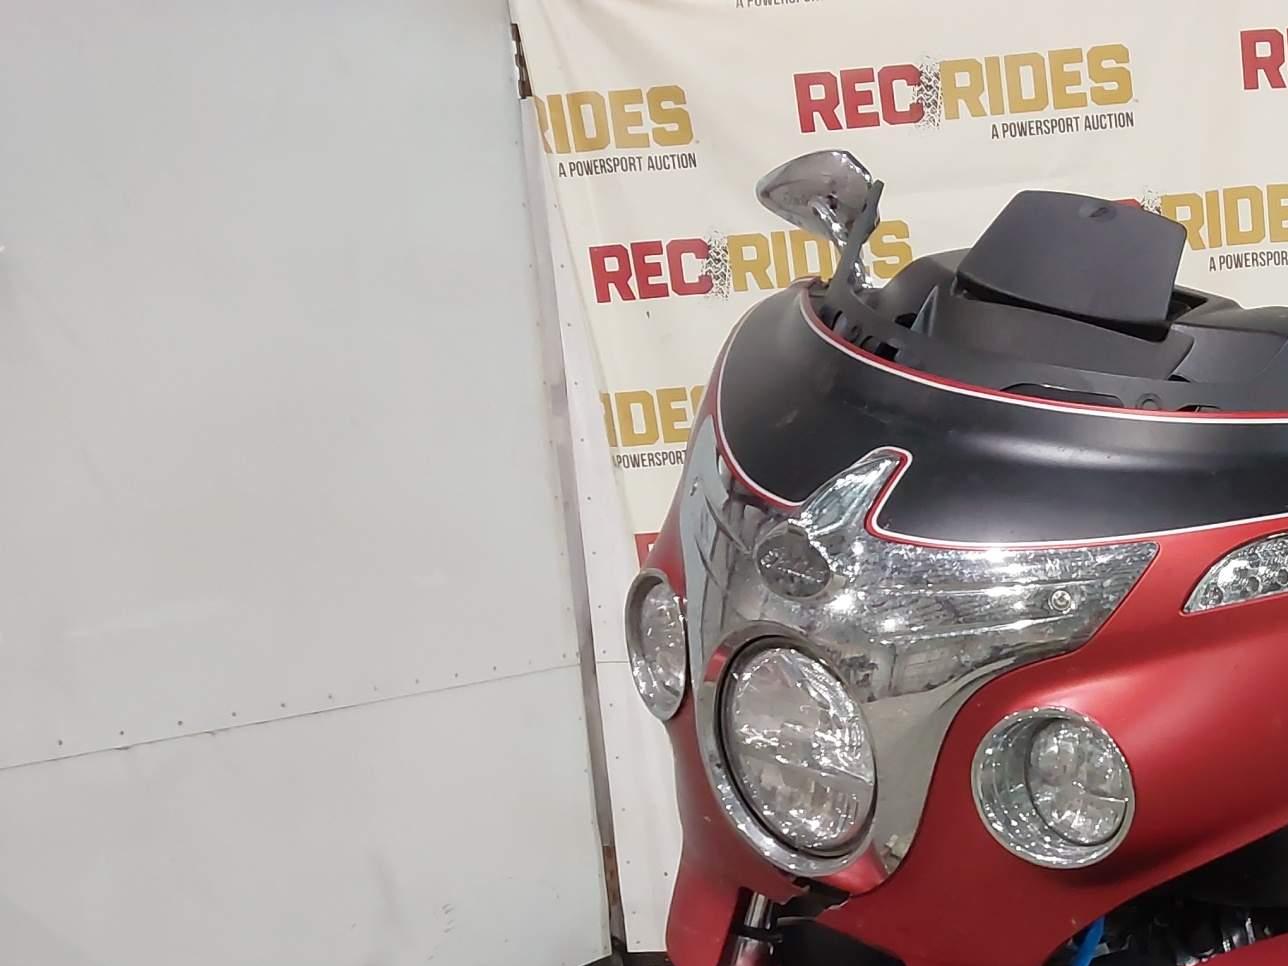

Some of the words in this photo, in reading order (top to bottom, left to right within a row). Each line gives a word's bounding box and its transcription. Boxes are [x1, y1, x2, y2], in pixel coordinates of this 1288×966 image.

[794, 64, 925, 133] REC
[938, 44, 1133, 120] RIDES
[991, 124, 999, 140] A
[1001, 116, 1080, 138] POWERSPORT
[1084, 112, 1134, 131] AUCTION
[558, 162, 567, 178] A
[568, 156, 642, 177] POWERSPORT
[647, 152, 697, 171] AUCTION
[590, 239, 714, 304] REC
[726, 218, 914, 293] RIDS
[1209, 256, 1217, 272] A
